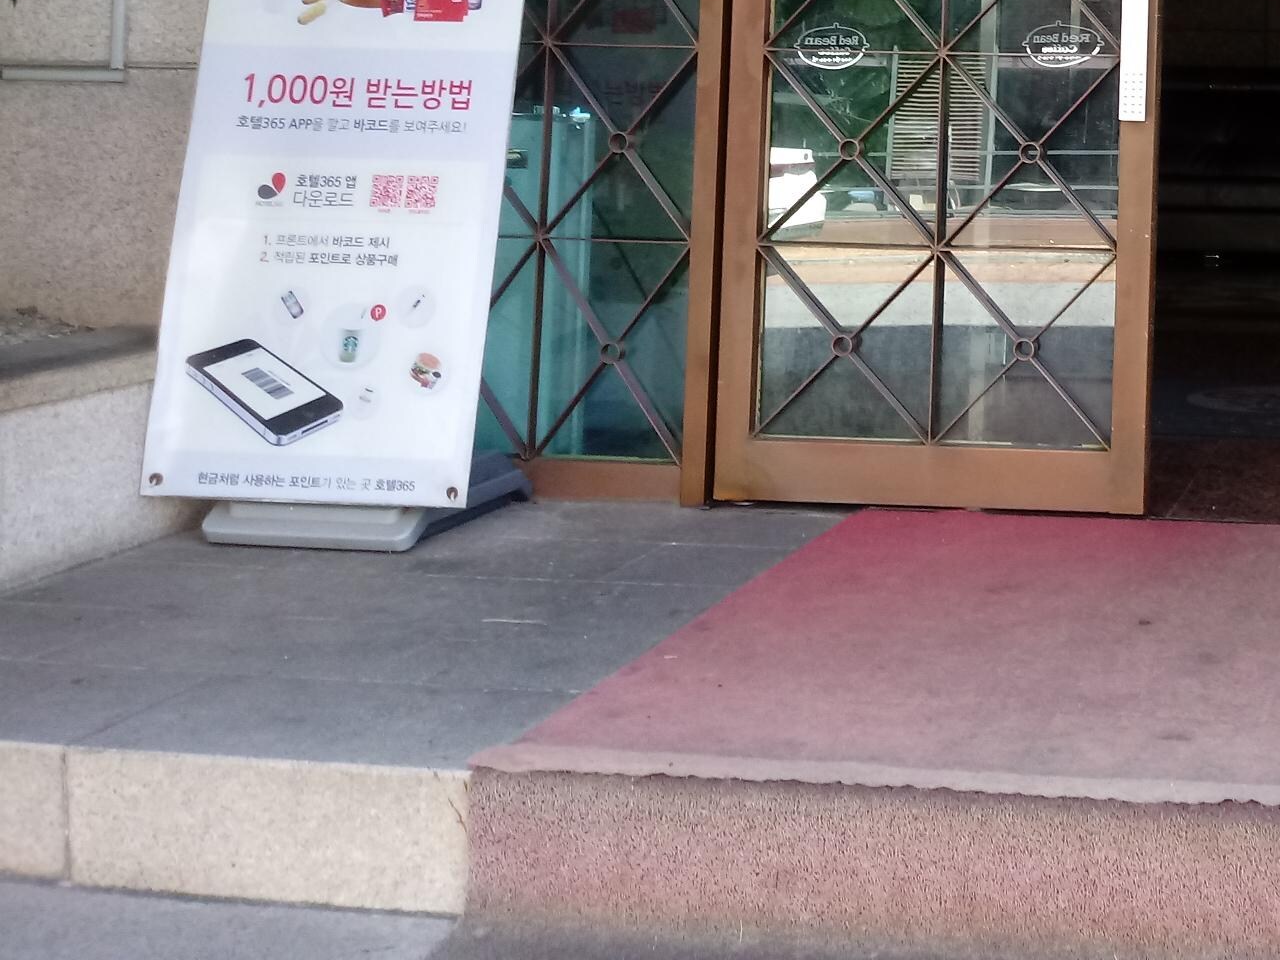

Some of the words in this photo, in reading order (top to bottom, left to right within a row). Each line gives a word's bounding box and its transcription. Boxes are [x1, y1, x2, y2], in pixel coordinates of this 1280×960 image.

[243, 73, 355, 108] 1,000원
[366, 78, 473, 110] 받는방법
[236, 114, 286, 130] 호텔365
[288, 117, 323, 131] APP을
[353, 118, 400, 133] 바코드를
[295, 175, 342, 189] 호텔365
[345, 175, 357, 189] 앱
[293, 191, 355, 208] 다운로드
[332, 236, 364, 248] 바코드
[368, 237, 390, 249] 제시
[308, 252, 352, 265] 포인트로
[355, 254, 399, 267] 상품구매
[198, 471, 240, 486] 현금처럼
[243, 473, 287, 487] 사용하는
[289, 475, 332, 489] 포인트가
[374, 479, 416, 492] 호텔365
